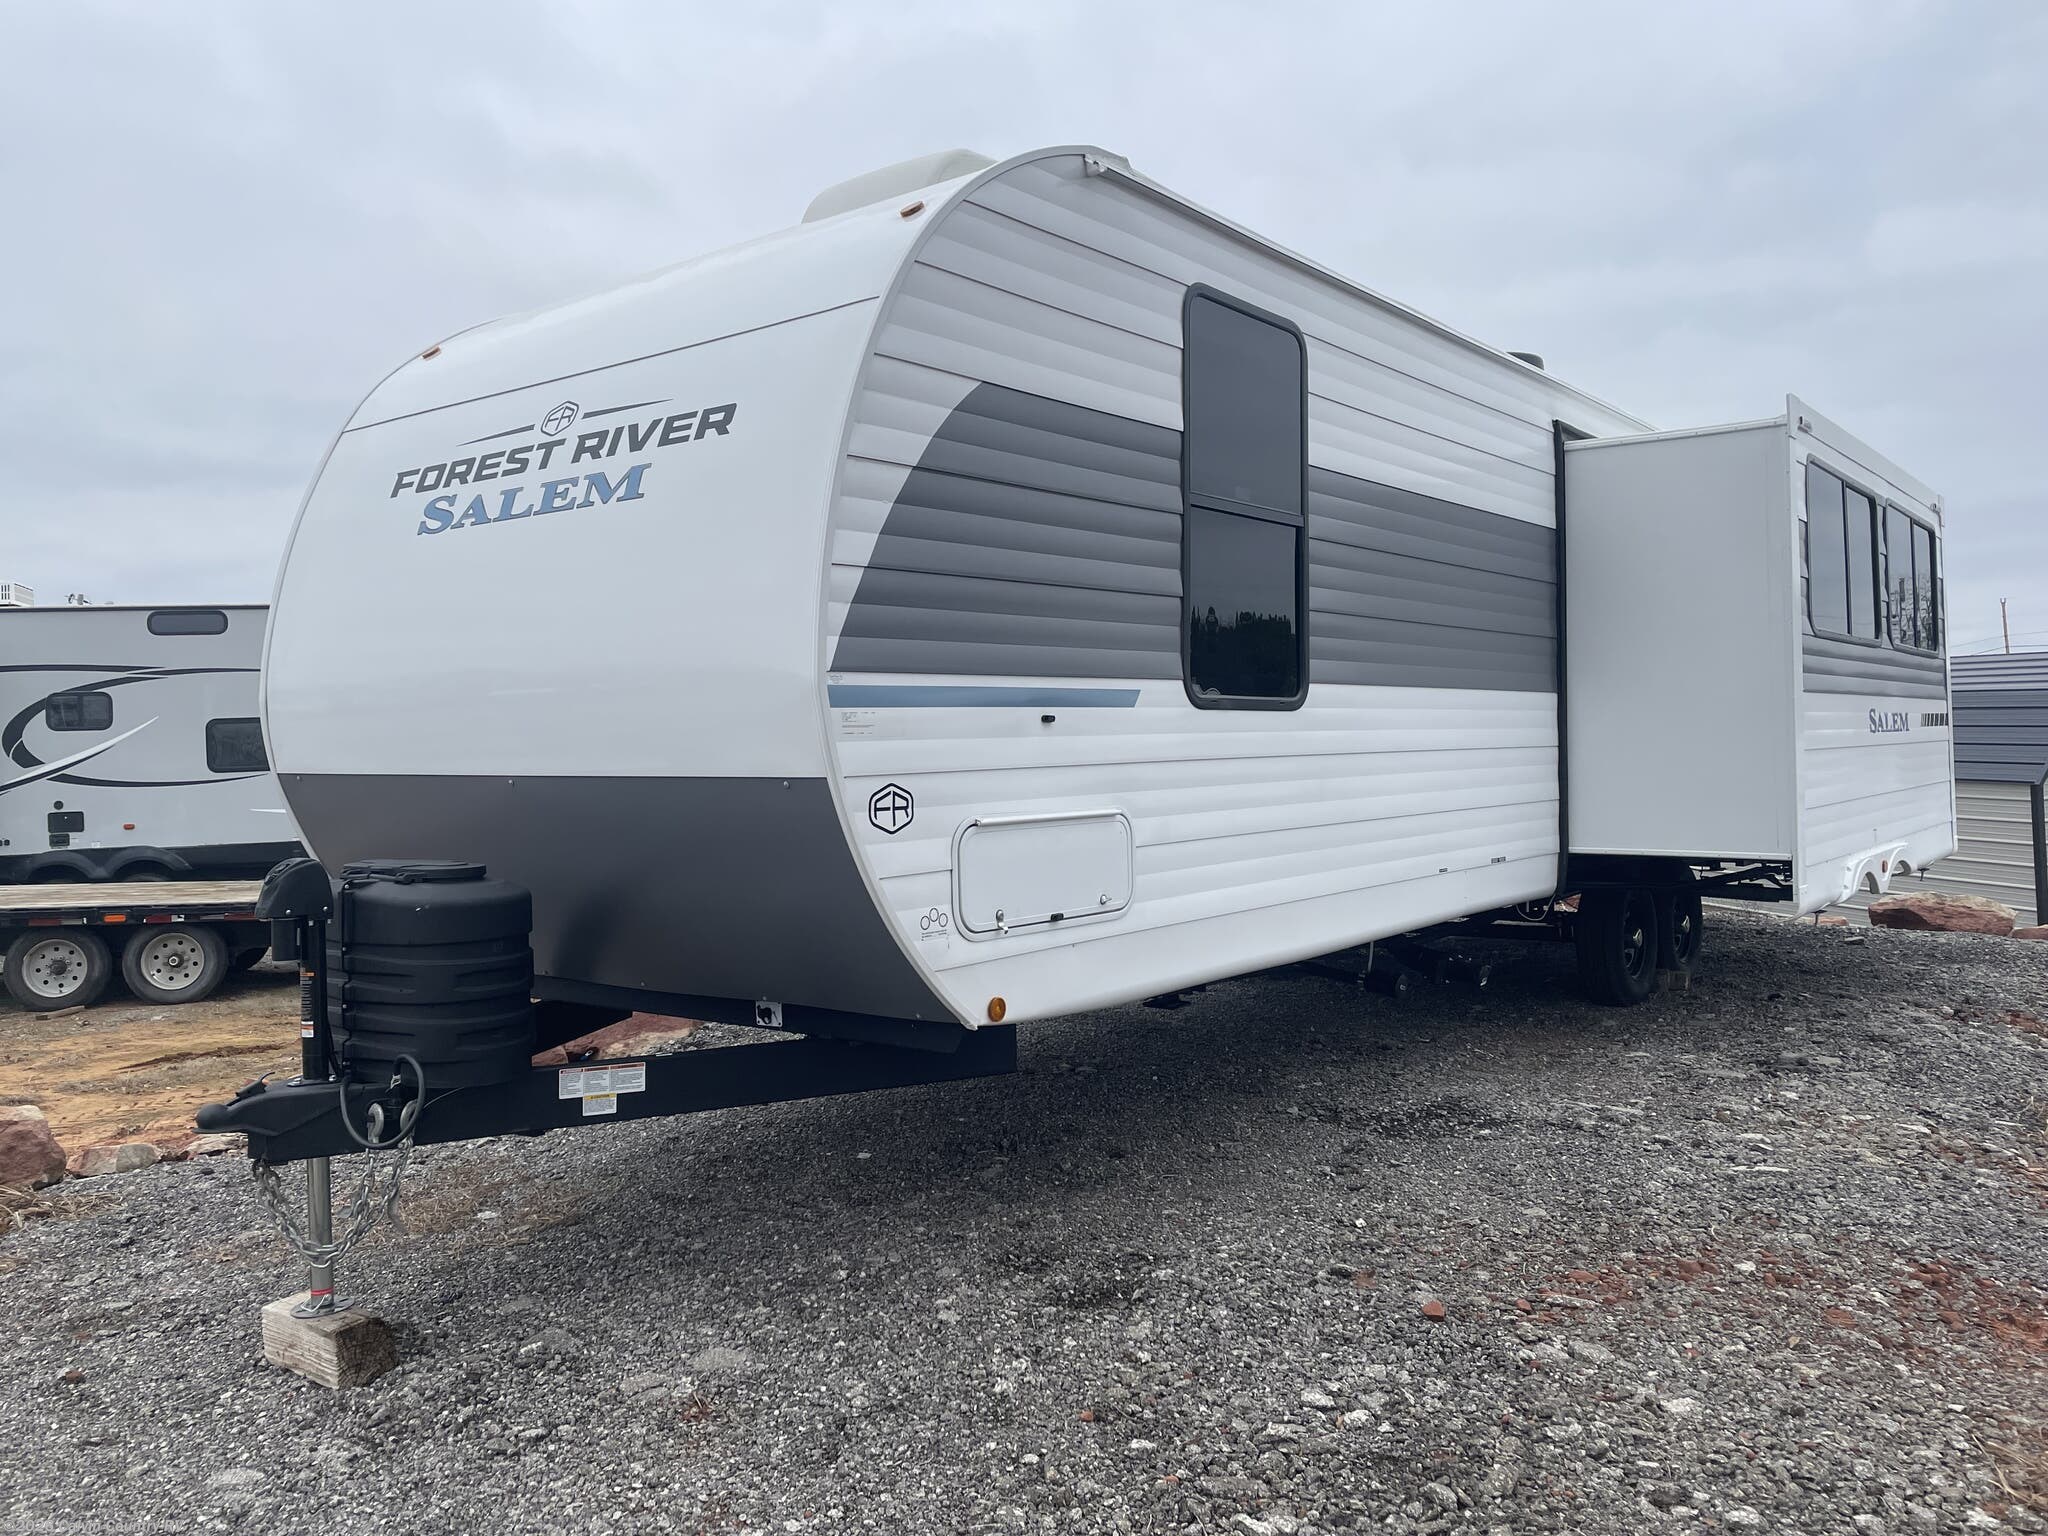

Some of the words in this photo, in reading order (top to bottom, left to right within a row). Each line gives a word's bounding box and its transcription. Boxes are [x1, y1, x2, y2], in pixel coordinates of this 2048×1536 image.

[390, 438, 567, 498] FOREST
[570, 402, 738, 464] RIVER
[417, 463, 652, 535] SALEM
